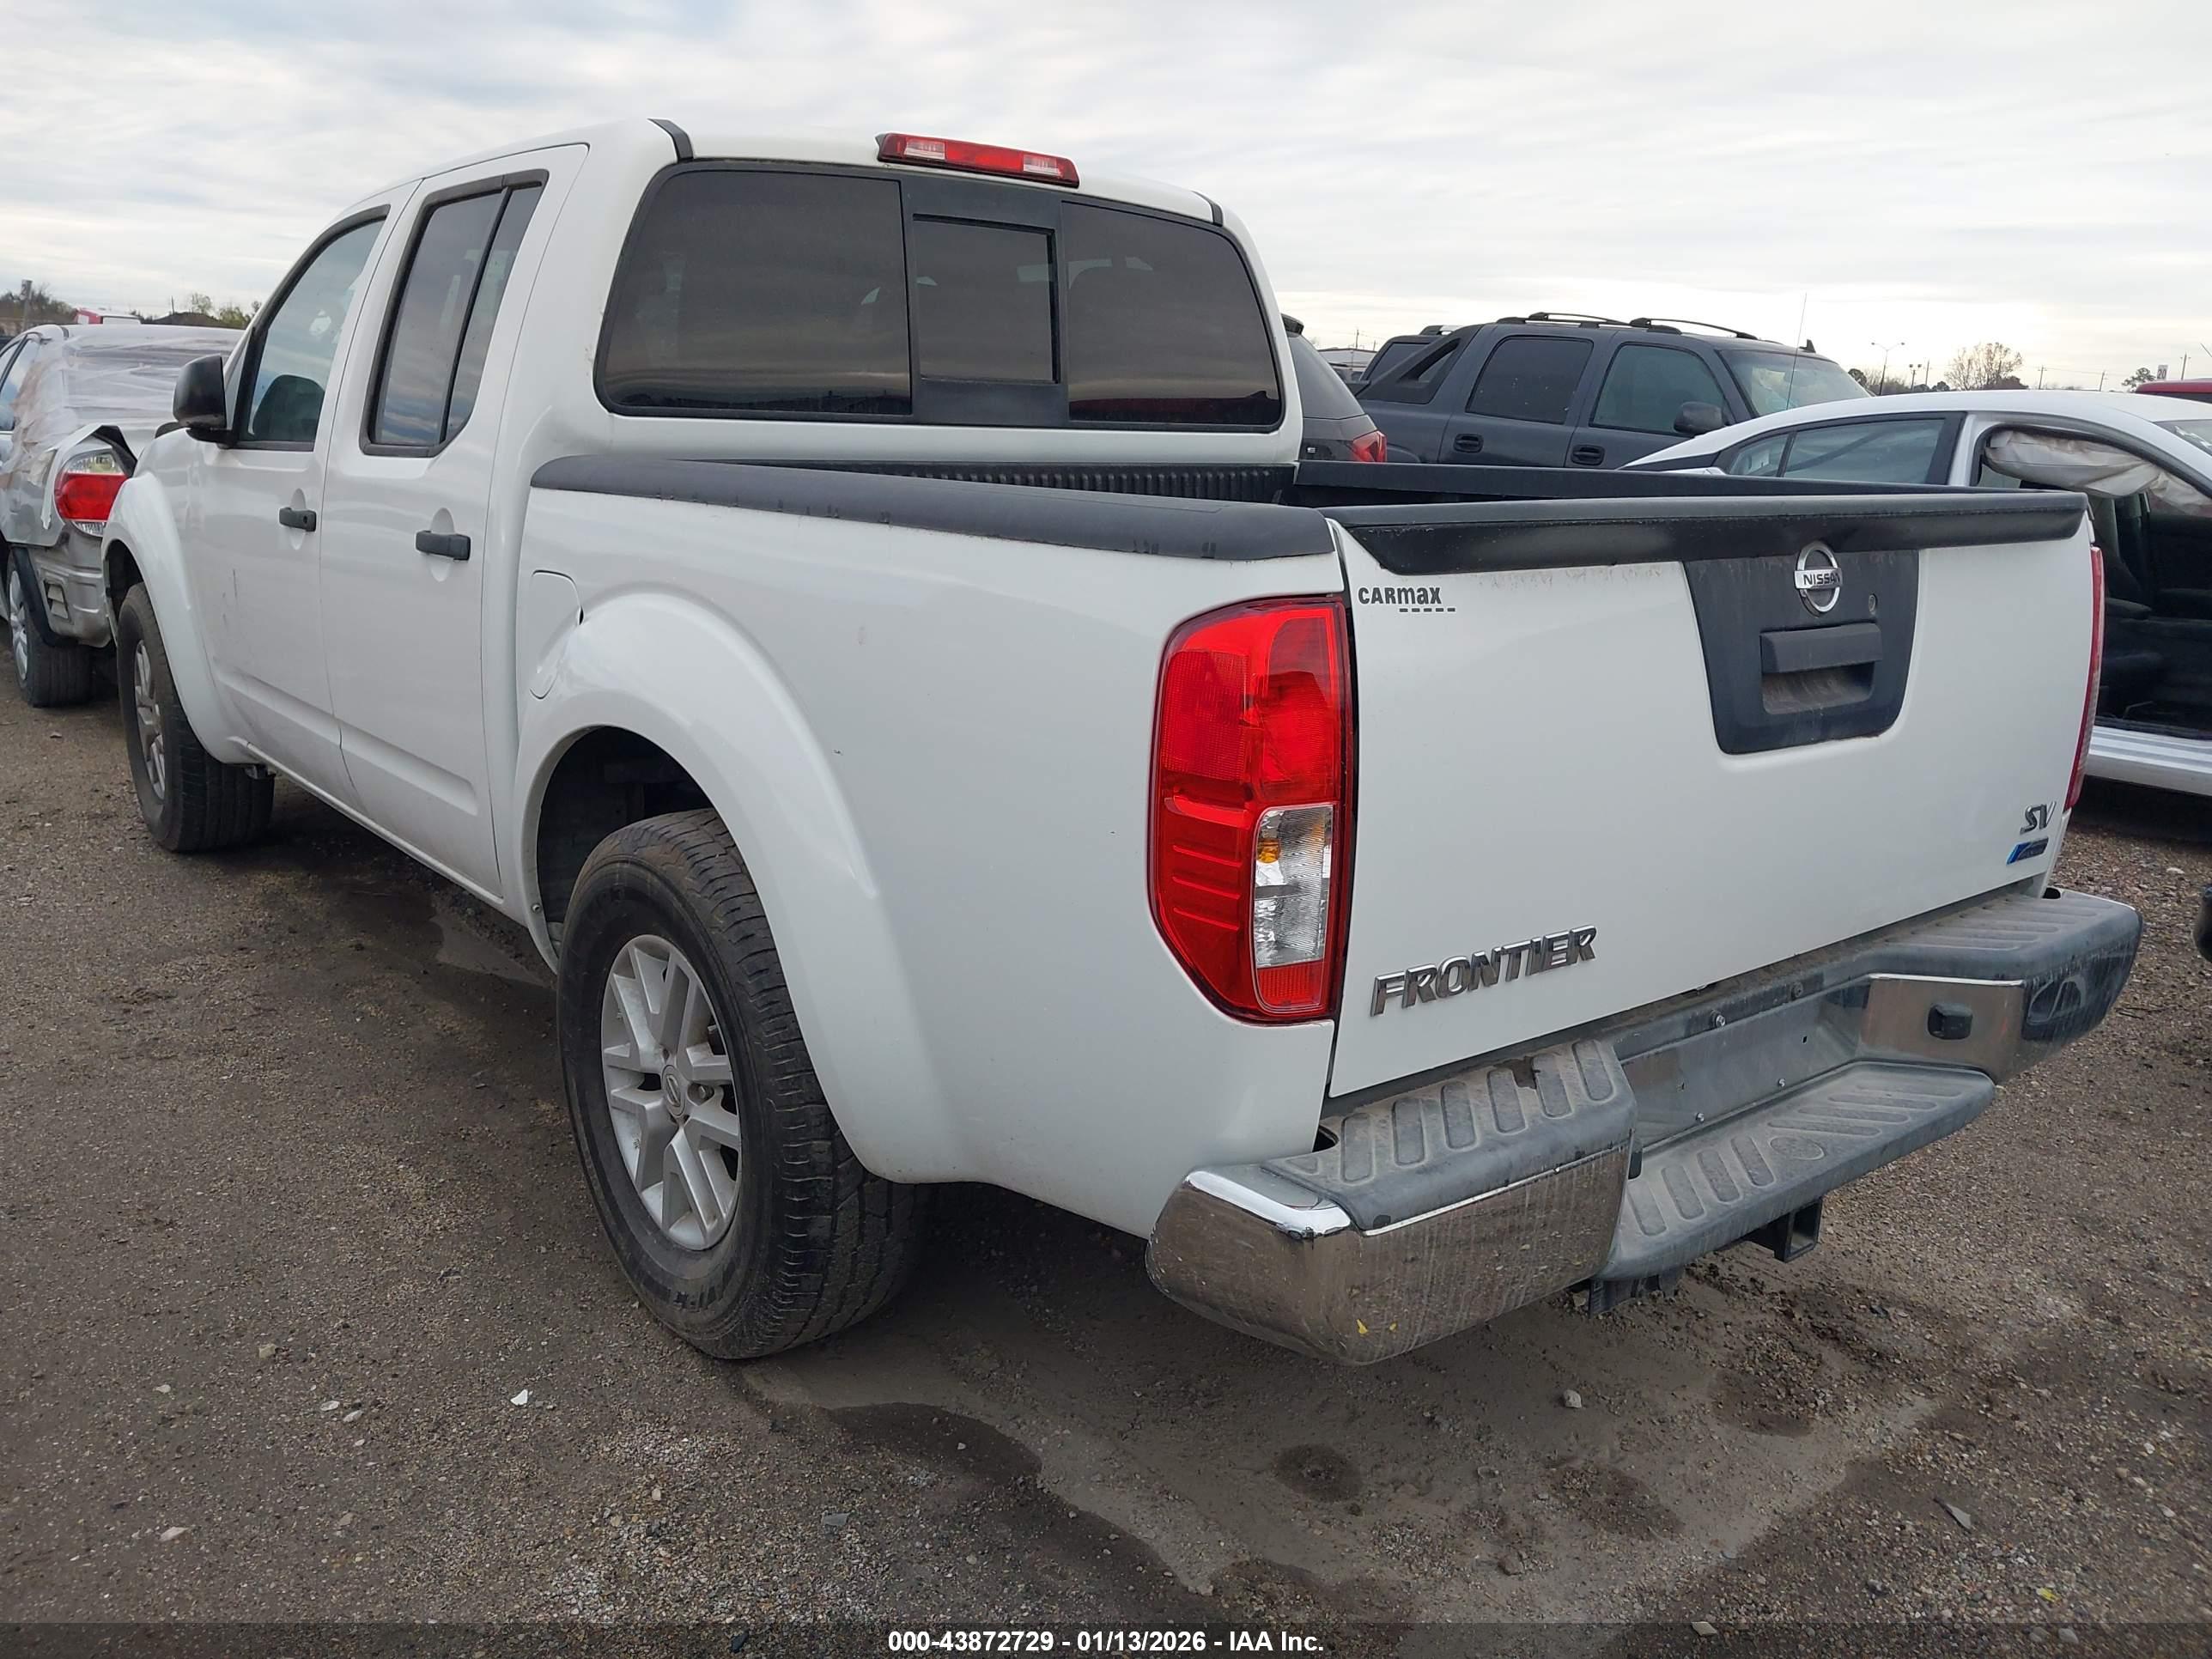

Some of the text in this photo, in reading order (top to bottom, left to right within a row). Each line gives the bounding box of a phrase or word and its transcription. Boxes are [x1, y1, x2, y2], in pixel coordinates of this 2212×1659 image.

[1803, 572, 1841, 586] NISSAN
[2019, 800, 2057, 836] SV
[1370, 924, 1597, 1018] FRONTIER
